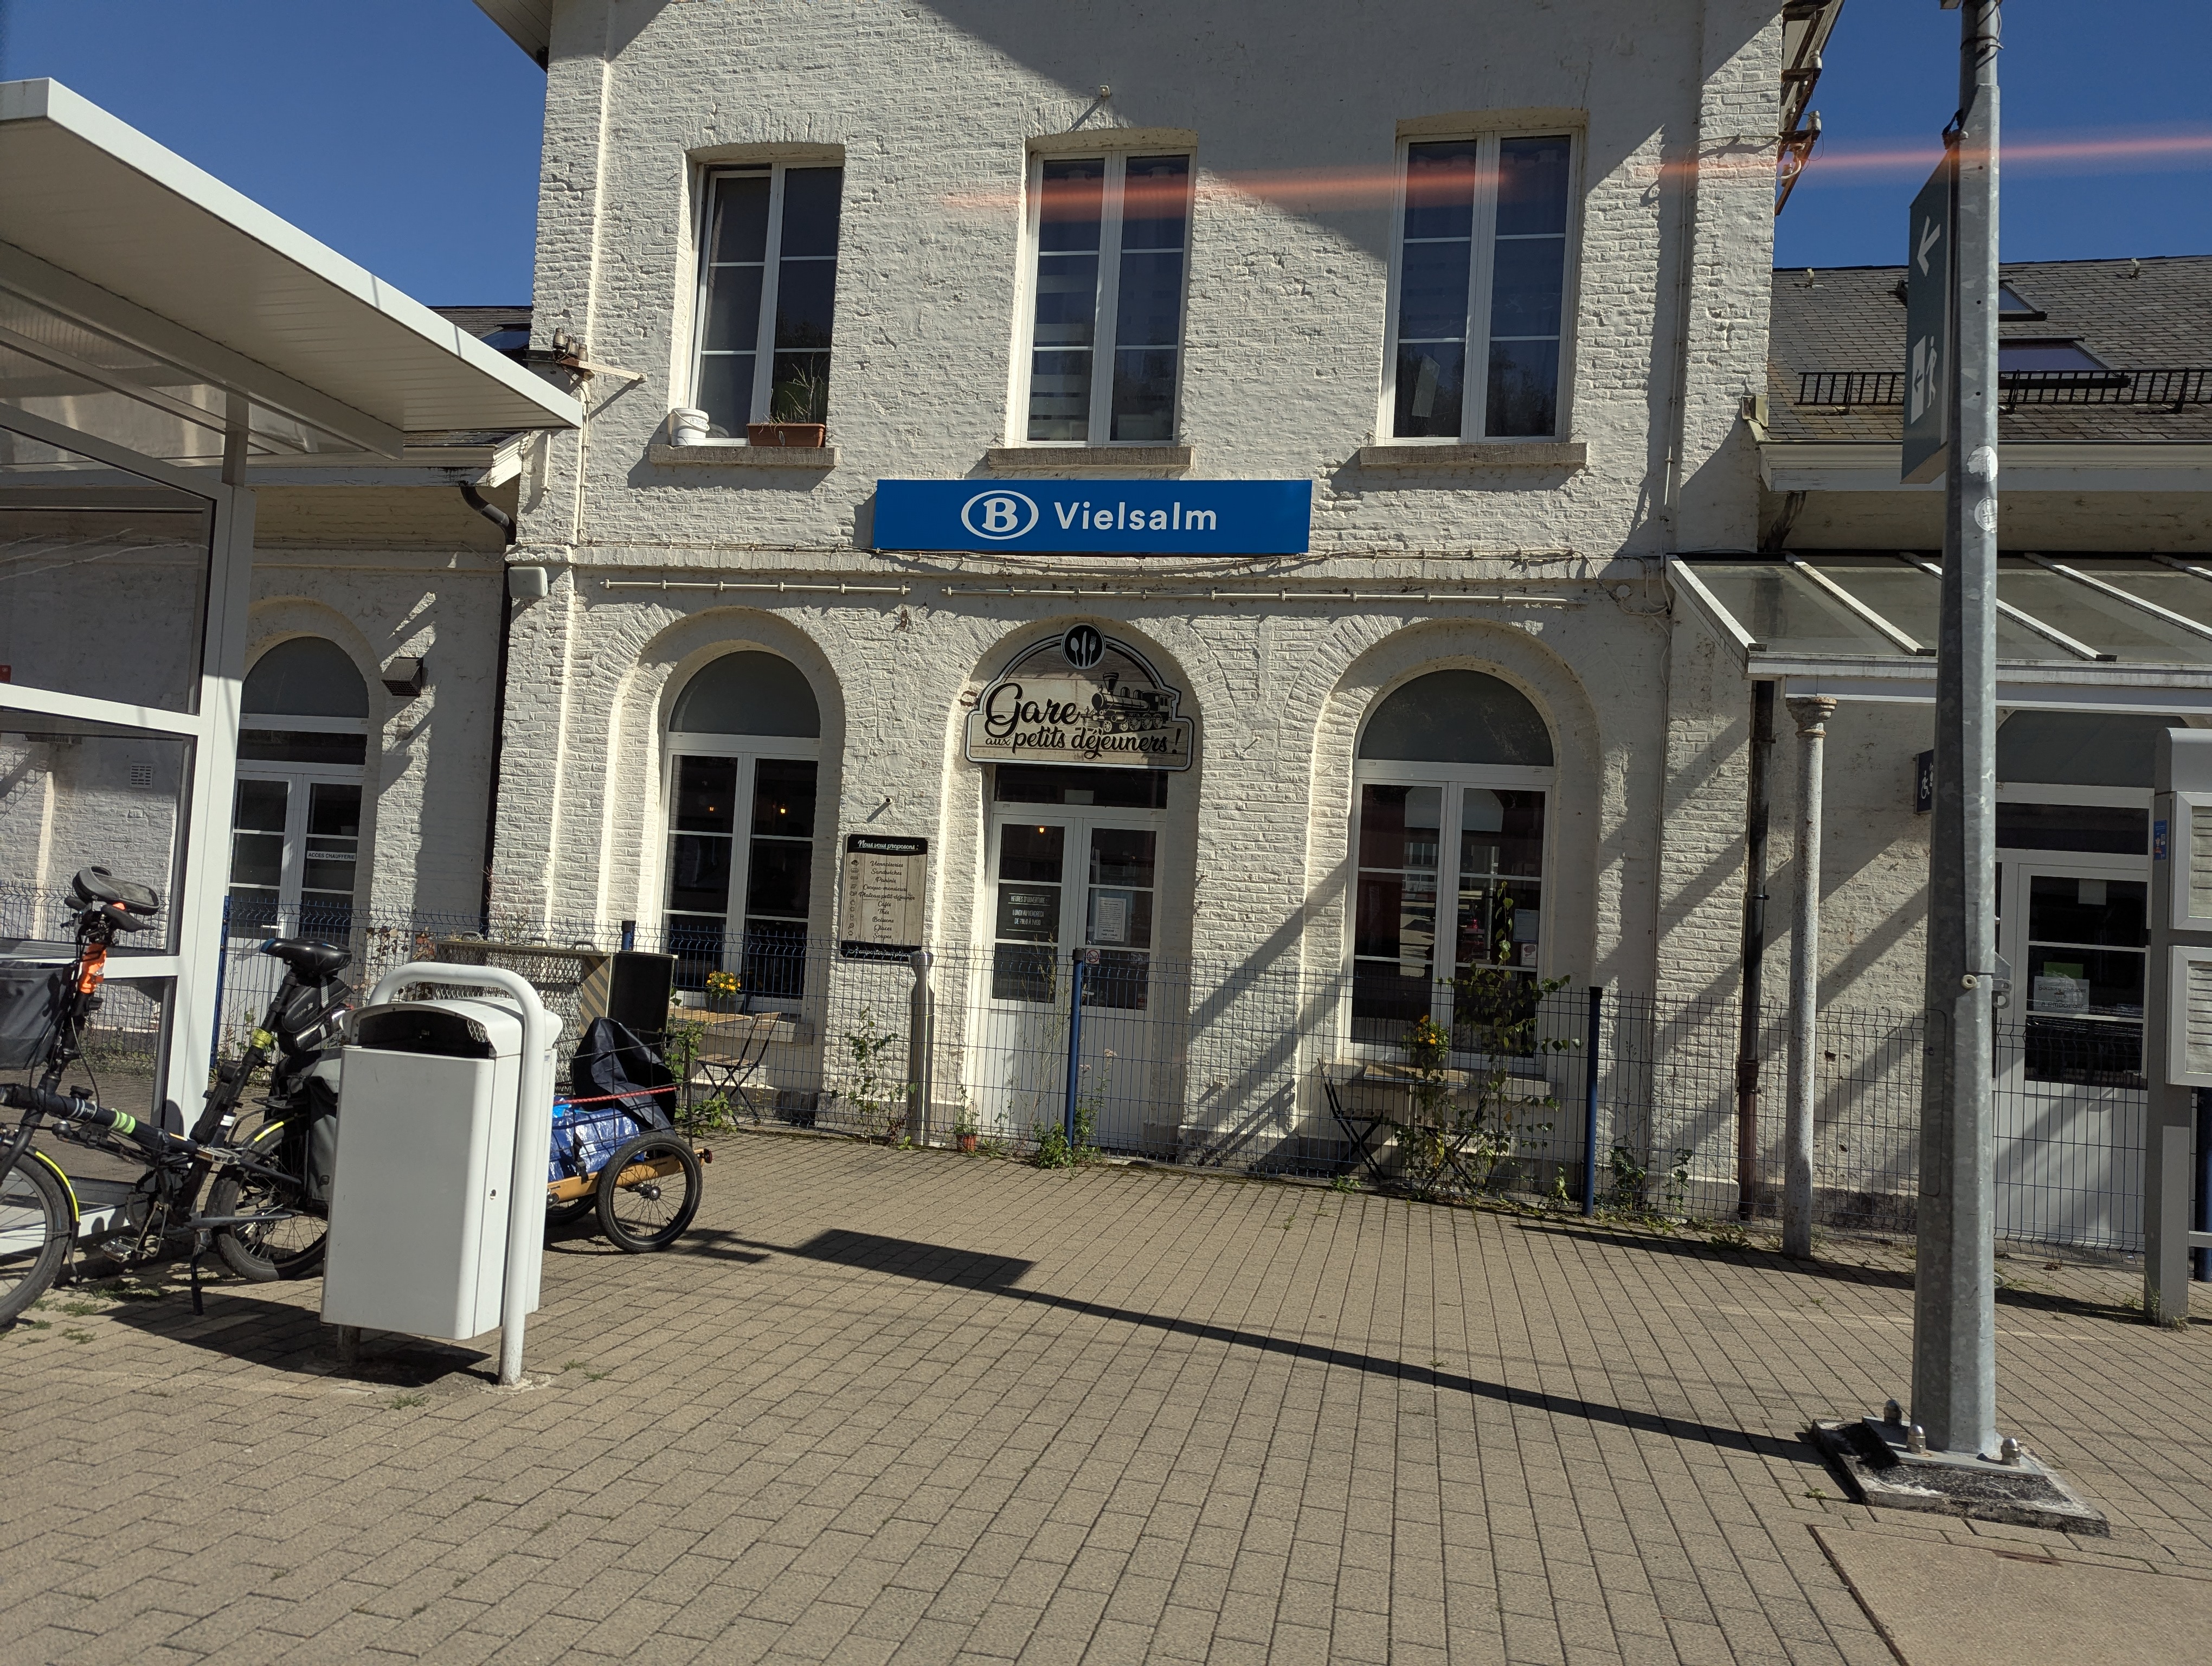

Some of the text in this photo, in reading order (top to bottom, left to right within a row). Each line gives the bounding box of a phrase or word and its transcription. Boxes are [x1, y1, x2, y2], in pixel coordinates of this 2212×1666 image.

[1054, 501, 1217, 530] Vielsalm
[985, 682, 1082, 738] Gare
[985, 738, 1011, 746] aux
[1013, 726, 1065, 754] petits
[1071, 727, 1168, 759] déjeuners
